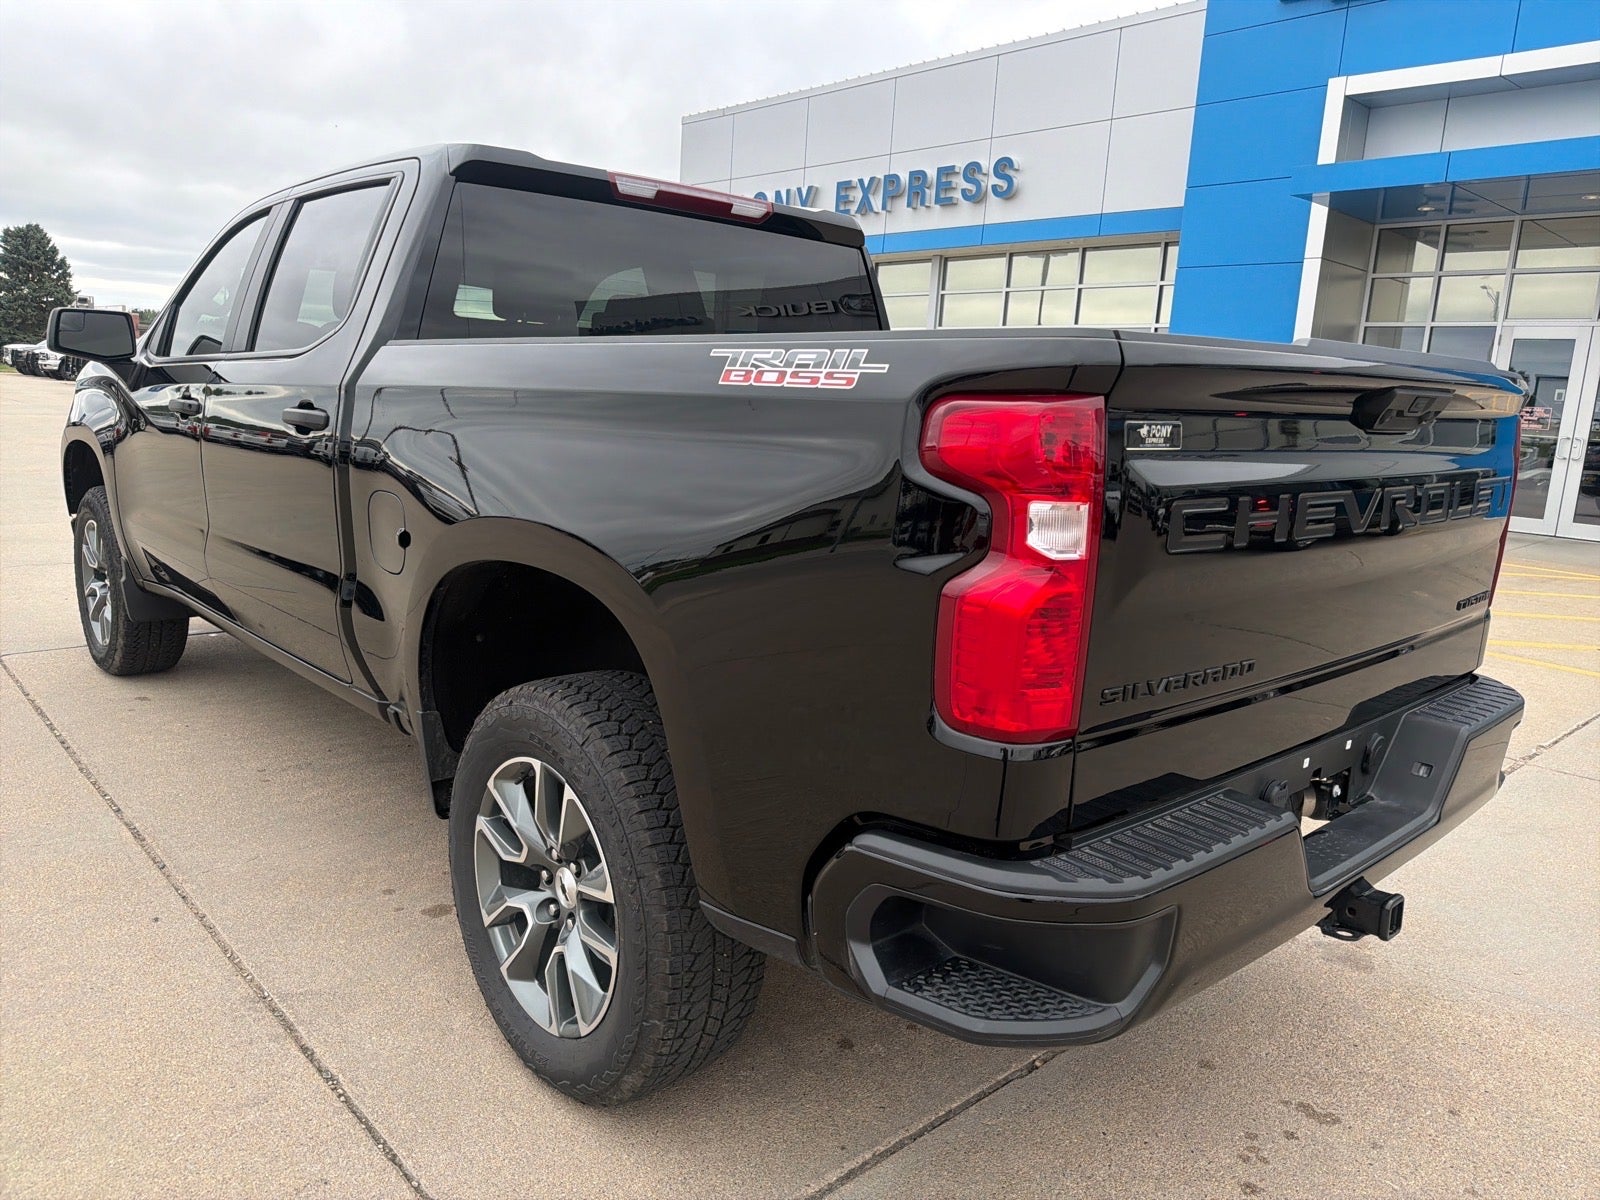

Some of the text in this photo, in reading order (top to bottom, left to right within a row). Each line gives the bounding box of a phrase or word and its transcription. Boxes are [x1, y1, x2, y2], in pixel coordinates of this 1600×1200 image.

[835, 156, 1019, 214] EXPRESS
[710, 349, 890, 373] TRAIL
[719, 368, 860, 389] BOSS
[1150, 425, 1172, 437] PONY
[1166, 476, 1512, 554] CHEVROLET
[1100, 659, 1256, 706] SILVERADO
